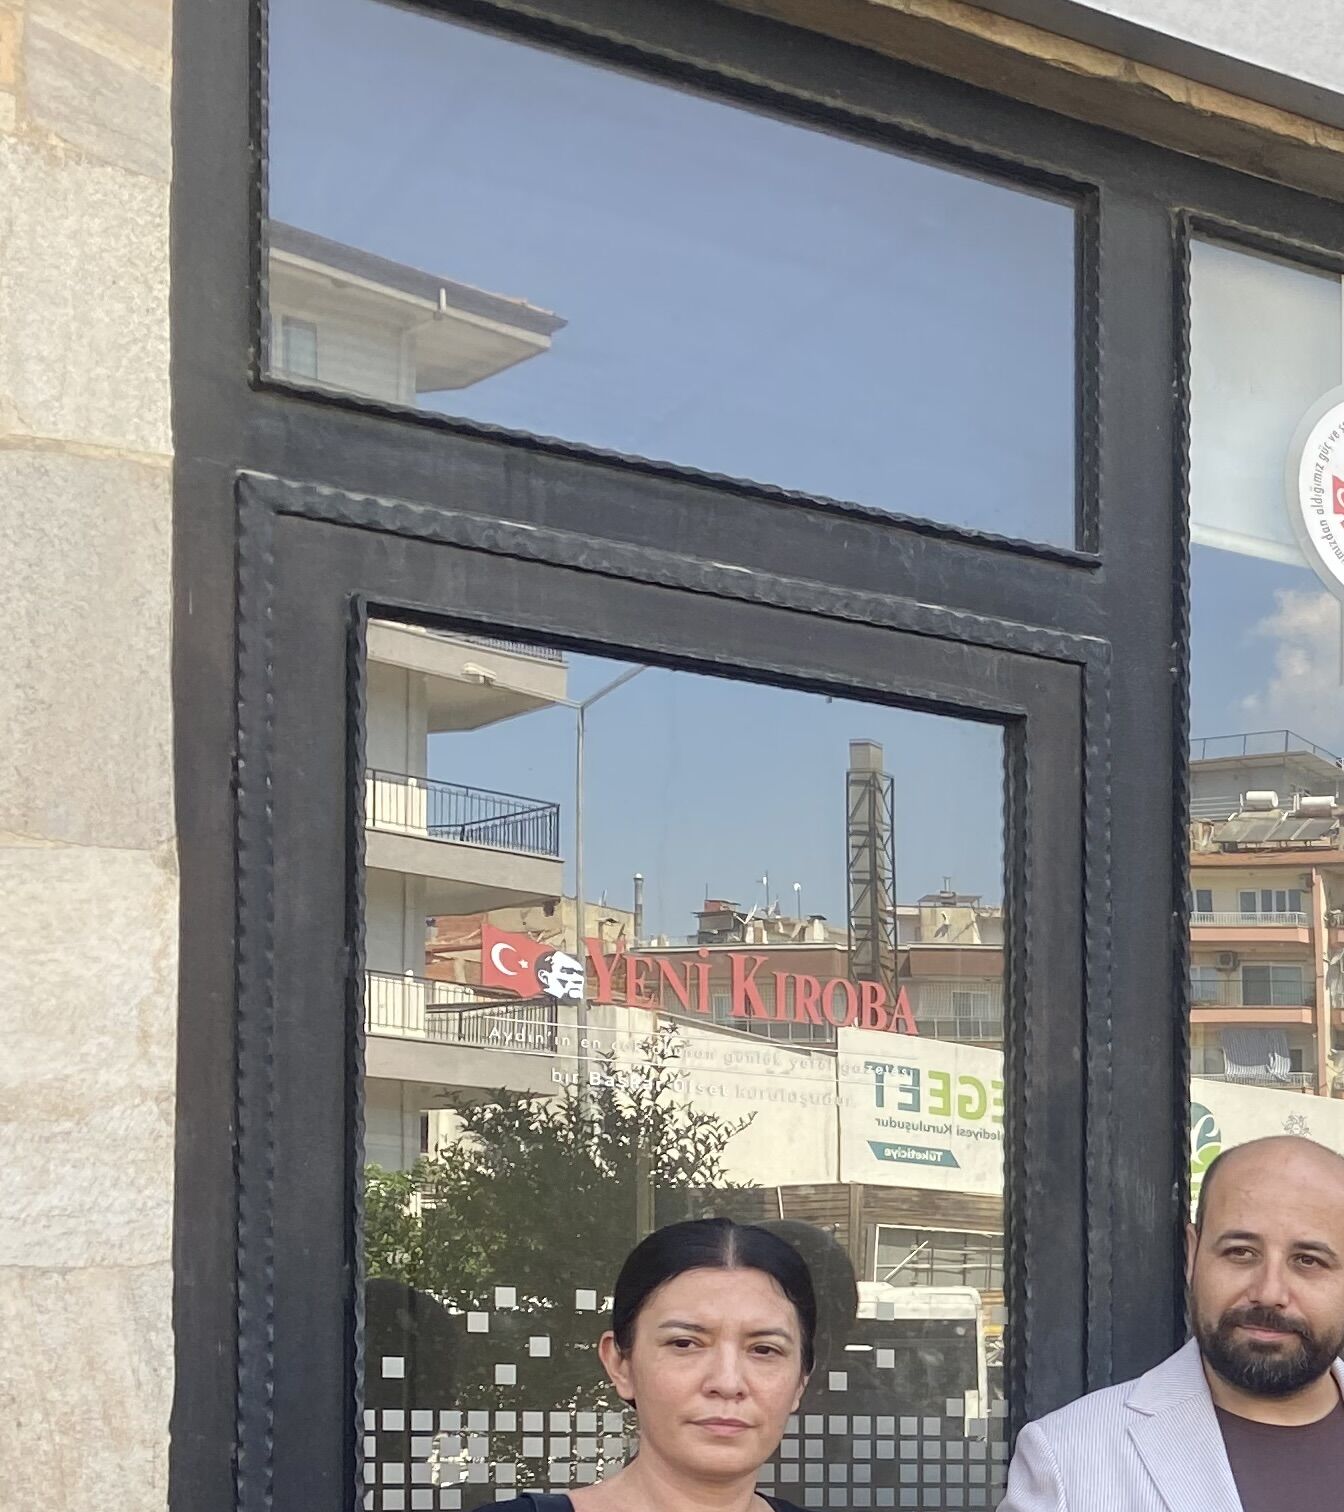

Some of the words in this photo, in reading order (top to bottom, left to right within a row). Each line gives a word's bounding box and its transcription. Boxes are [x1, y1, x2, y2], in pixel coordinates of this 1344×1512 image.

[1328, 430, 1340, 442] ve
[584, 937, 713, 1014] YENİ
[727, 951, 919, 1035] KIROBA
[580, 1037, 601, 1049] en
